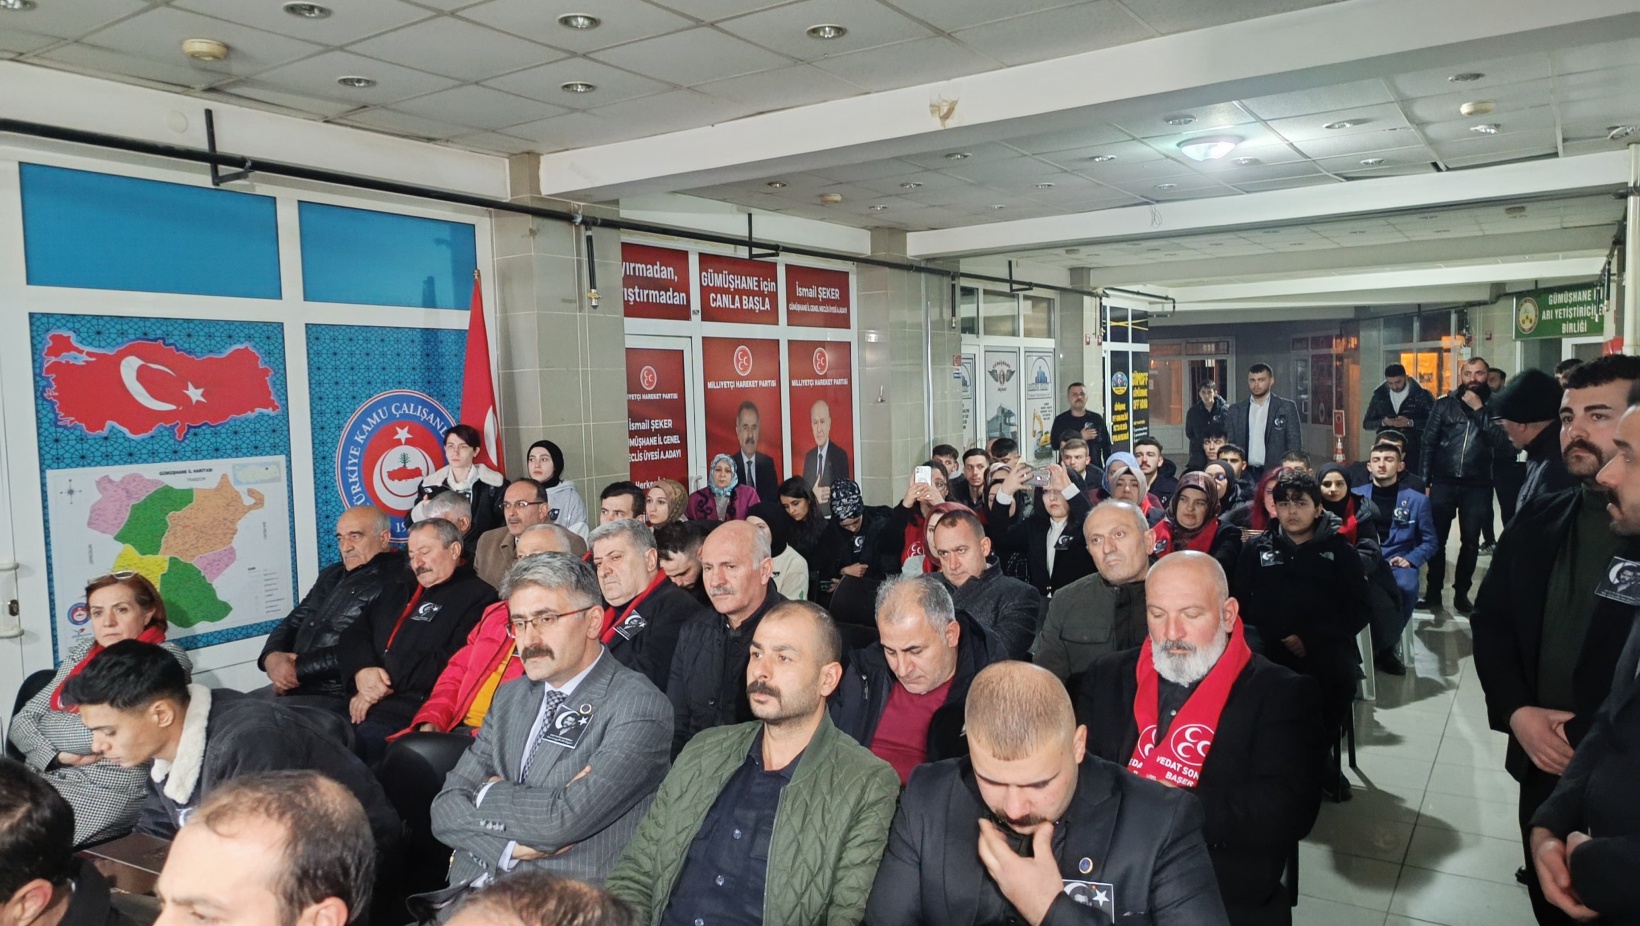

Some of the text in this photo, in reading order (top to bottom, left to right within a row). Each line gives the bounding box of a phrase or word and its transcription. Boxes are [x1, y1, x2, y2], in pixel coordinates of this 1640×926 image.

[701, 268, 776, 294] GÜMÜŞHANE için
[796, 281, 840, 302] İsmail ŞEKER
[1548, 289, 1592, 305] GÜMÜŞHANE
[709, 293, 771, 313] CANLA BAŞLA
[1542, 304, 1605, 320] ARI YETİŞTİRİCİLE
[1561, 320, 1587, 334] BİRLİĞİ
[707, 381, 735, 390] MİLLİYETÇİ
[736, 380, 758, 388] HAREKET
[814, 378, 833, 386] HAREKET
[354, 406, 389, 445] KAMU
[629, 418, 673, 432] İsmail ŞEKER
[657, 433, 663, 445] İL
[663, 435, 681, 444] GENEL
[643, 448, 660, 461] ÜYESİ
[660, 449, 681, 459] A.ADAYI
[346, 445, 366, 506] ÜRKİYE
[1156, 755, 1183, 772] VEDAT
[1165, 771, 1195, 788] BAŞER
